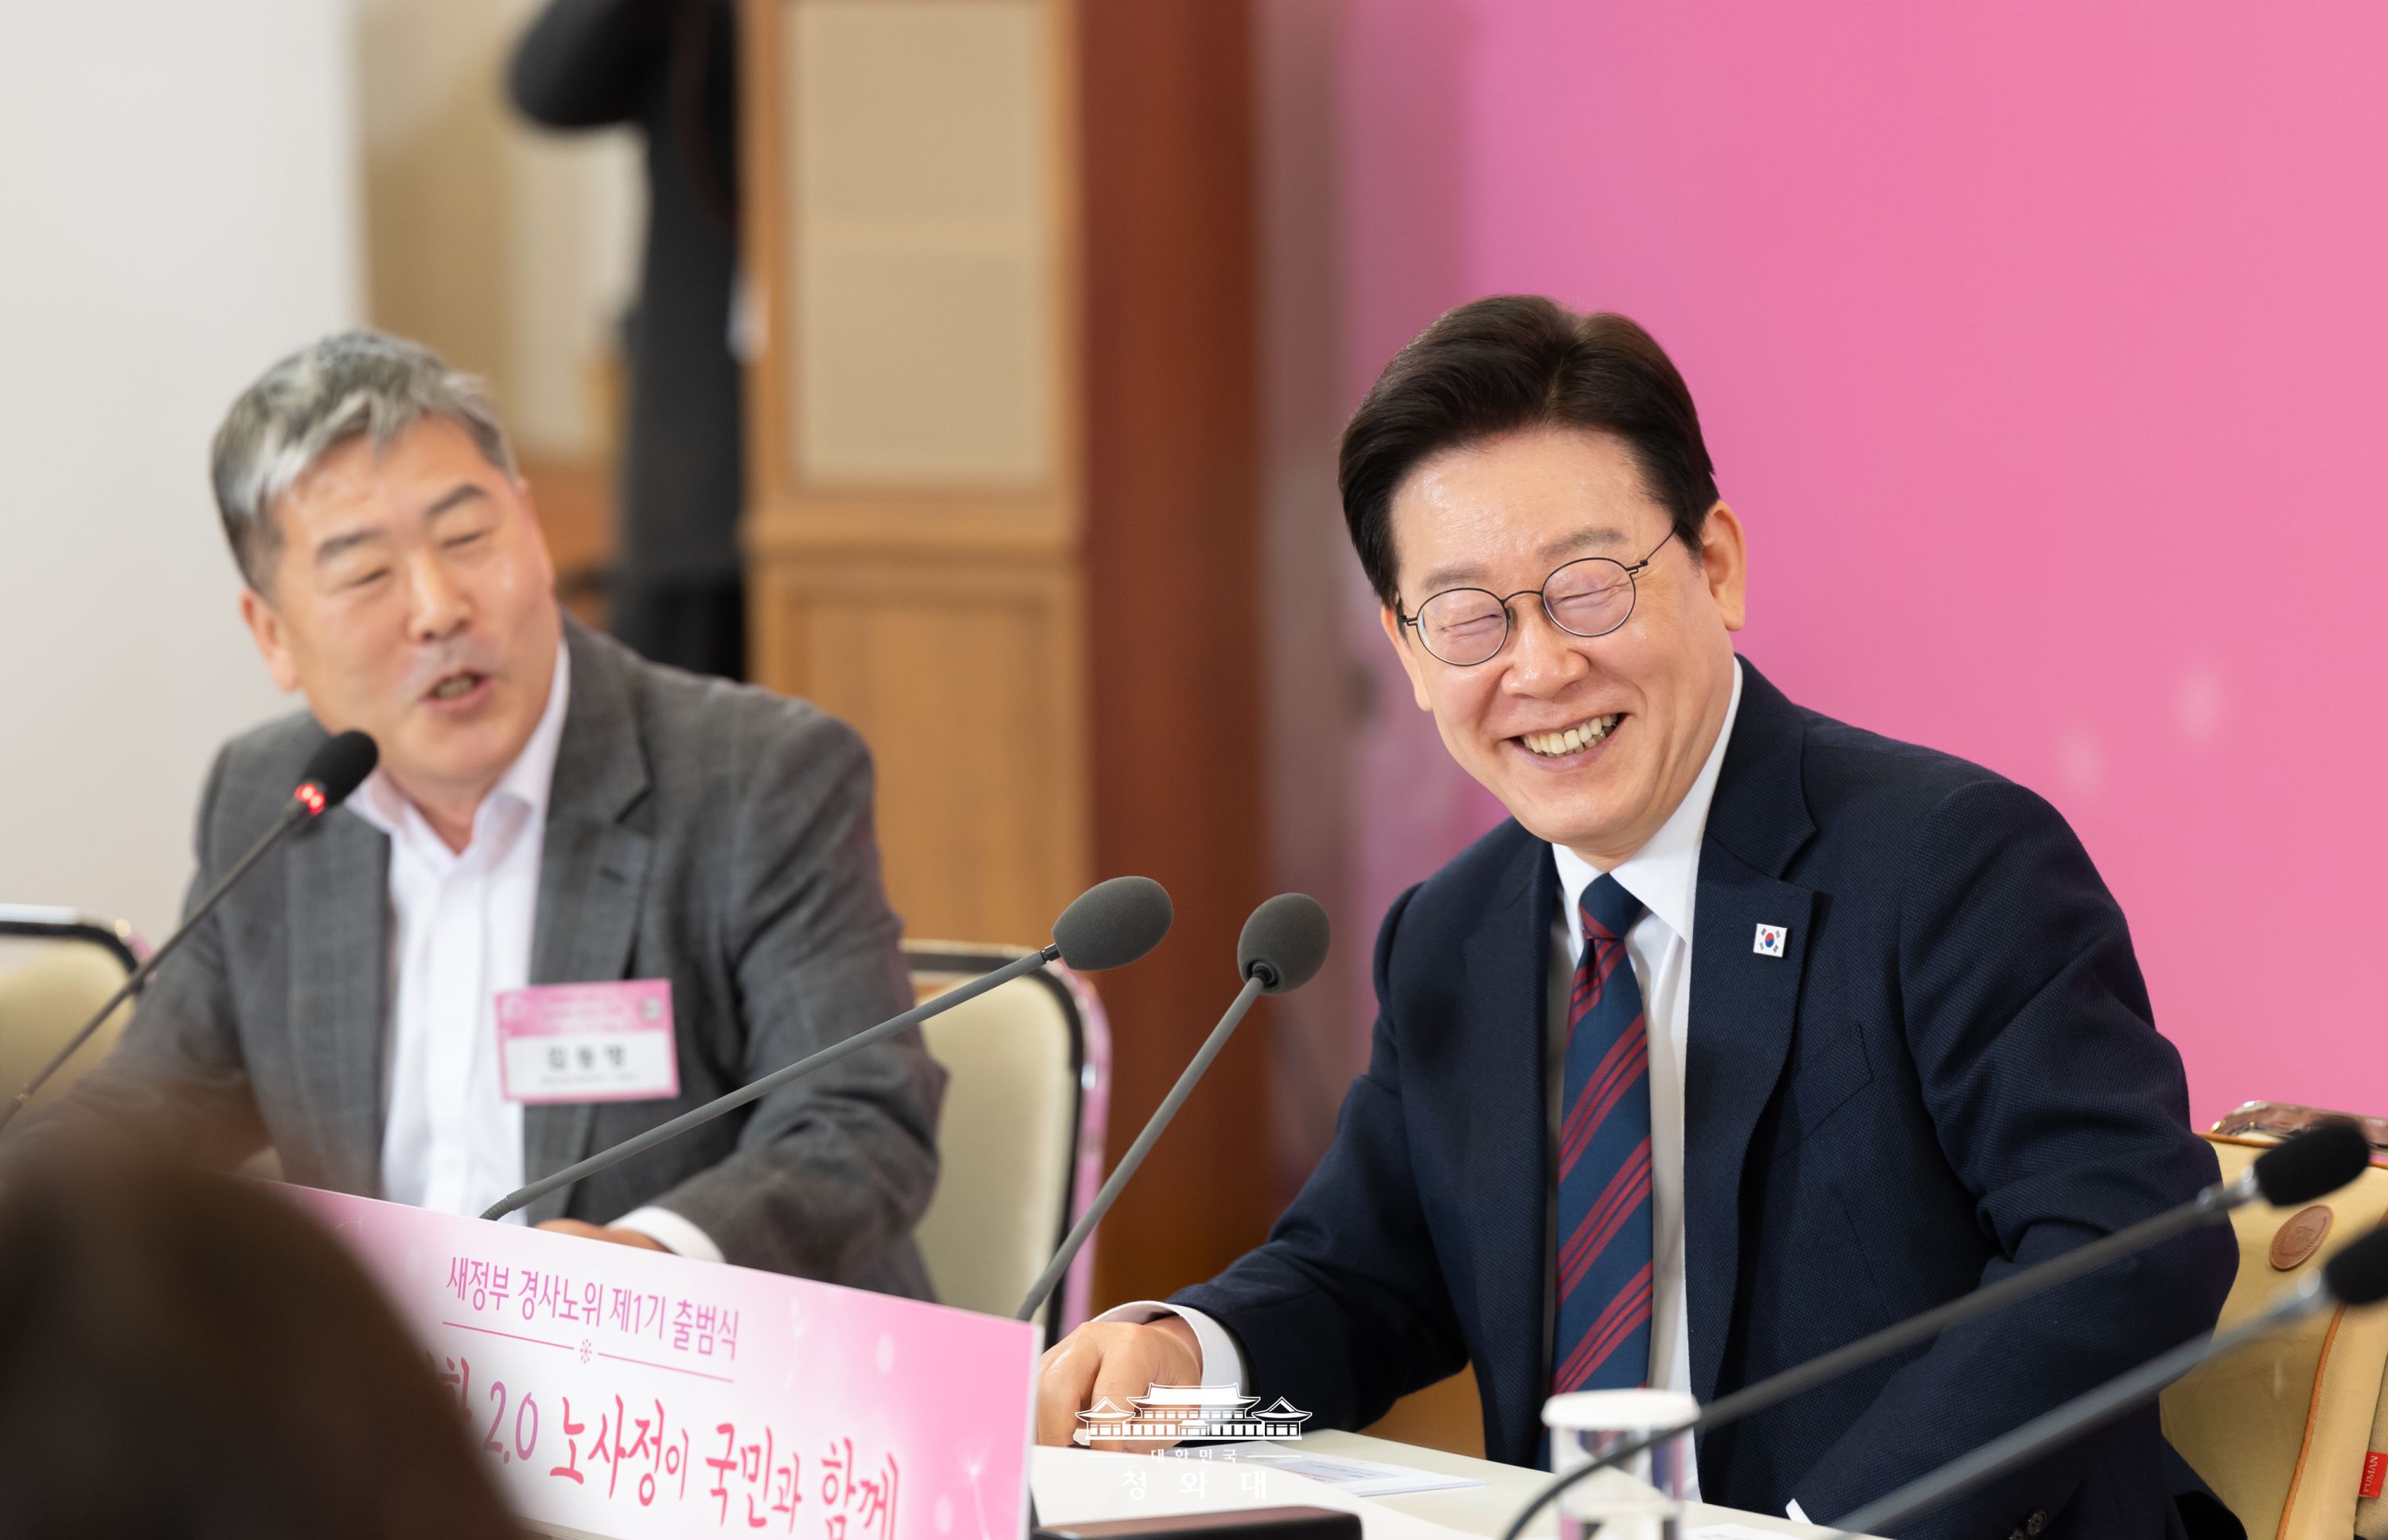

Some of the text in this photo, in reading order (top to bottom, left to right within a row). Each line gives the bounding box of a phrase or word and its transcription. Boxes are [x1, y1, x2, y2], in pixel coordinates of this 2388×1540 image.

[446, 1256, 739, 1360] 새정부 경사노위 제1기 출범식
[483, 1381, 539, 1464] 2.0
[549, 1394, 689, 1507] 노사정이
[705, 1423, 802, 1534] 국민과
[821, 1436, 900, 1540] 함께
